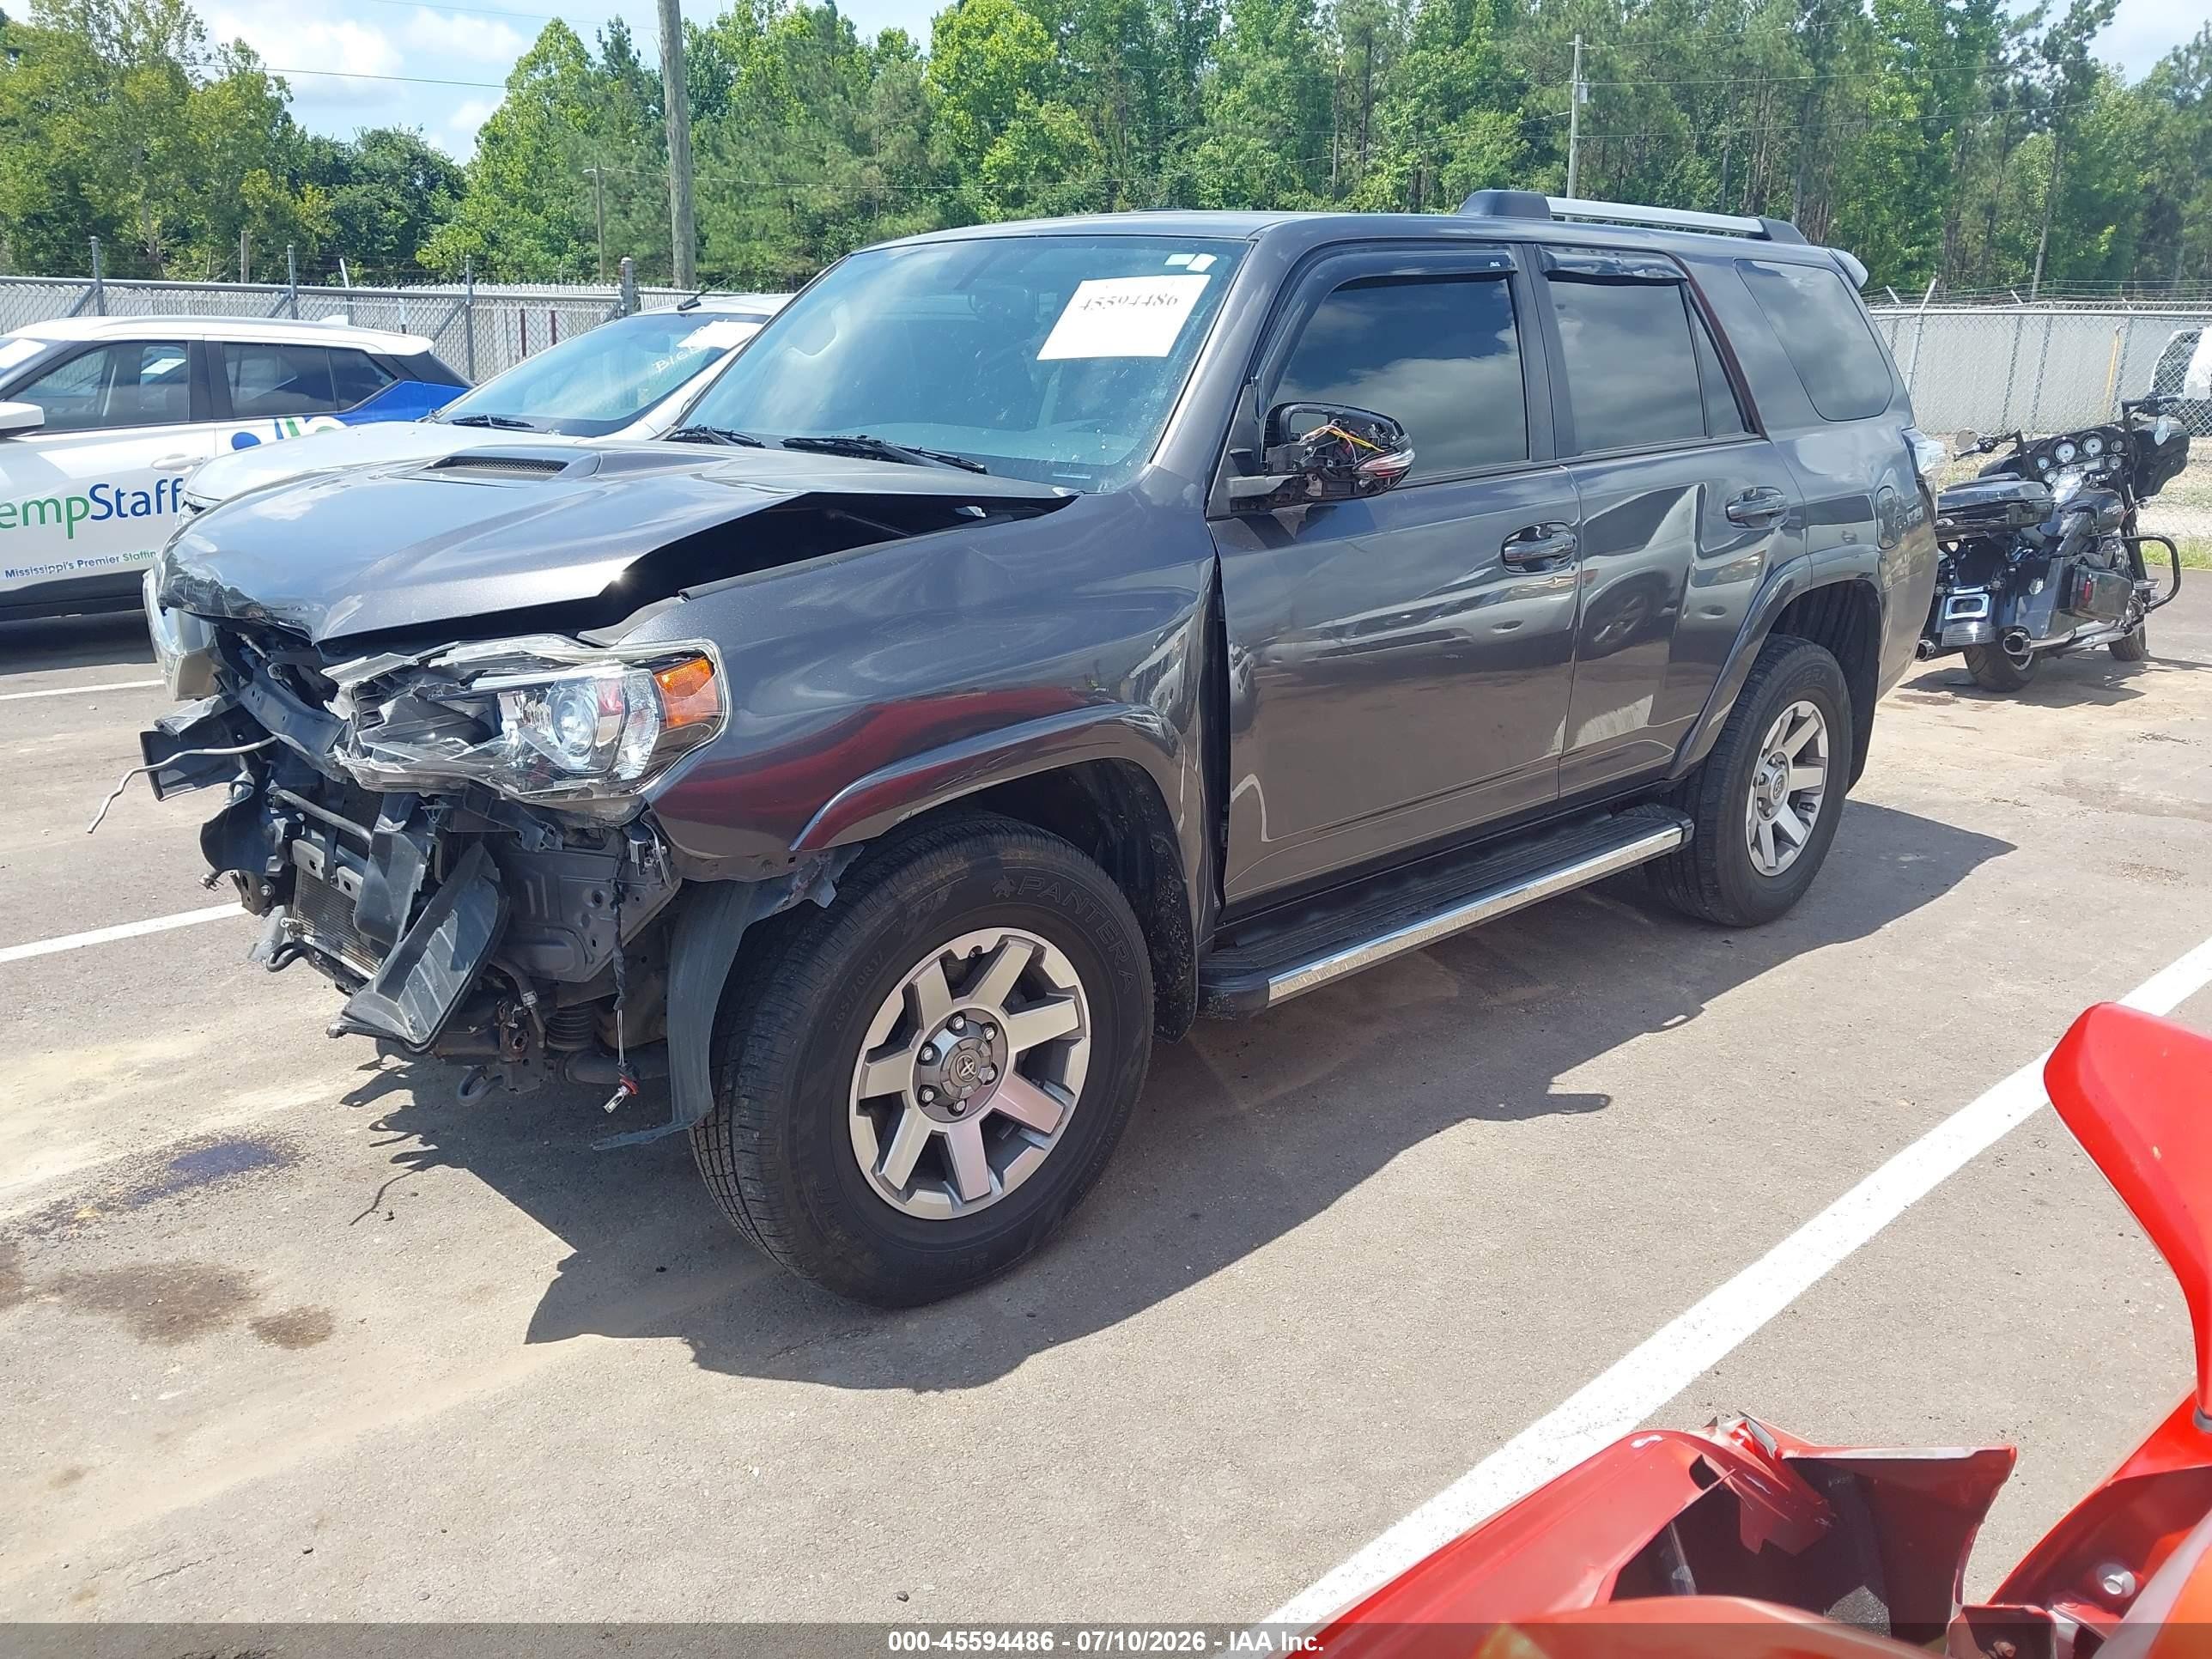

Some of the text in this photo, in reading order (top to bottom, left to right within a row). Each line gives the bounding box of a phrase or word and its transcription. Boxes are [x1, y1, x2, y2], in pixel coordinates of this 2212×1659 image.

[5, 560, 74, 579] Mississippi's
[77, 556, 120, 568] Premier
[1018, 876, 1136, 994] PANTERA
